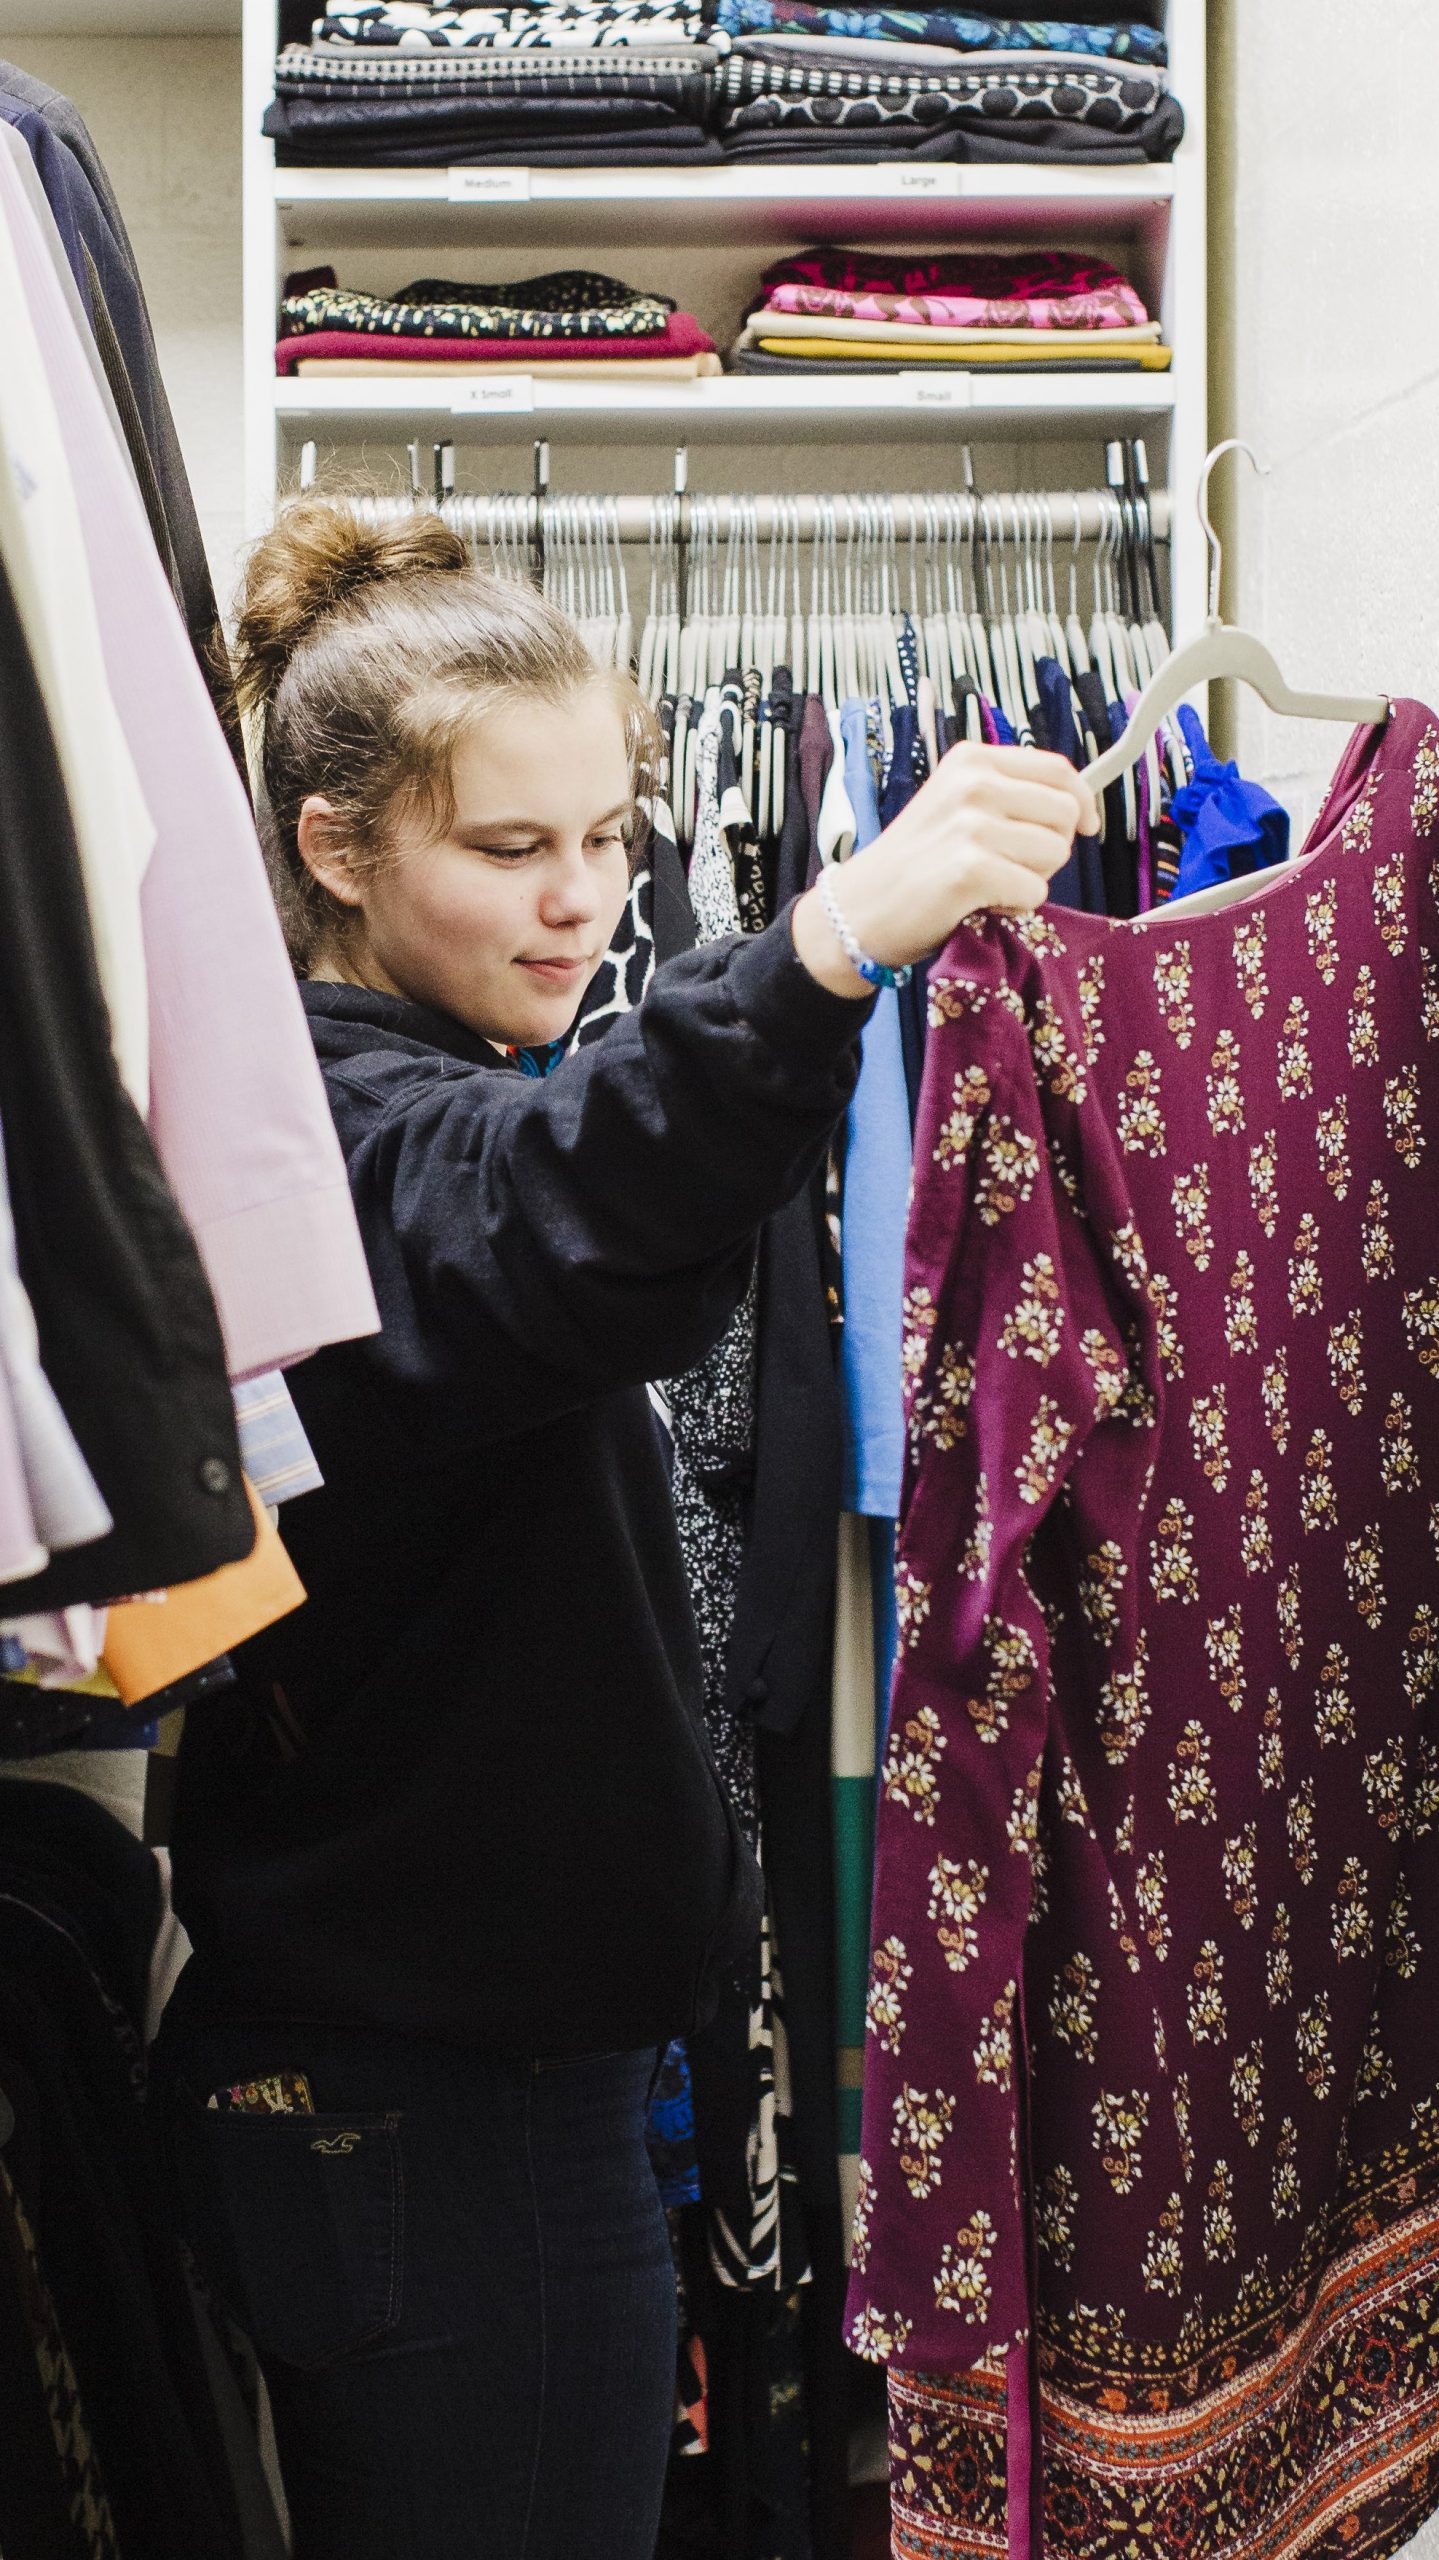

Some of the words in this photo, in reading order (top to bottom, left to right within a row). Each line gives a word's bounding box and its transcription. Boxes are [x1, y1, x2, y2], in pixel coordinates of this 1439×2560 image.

[464, 178, 512, 188] Medium
[902, 175, 936, 188] Large
[481, 388, 512, 399] Small
[916, 390, 952, 401] Small
